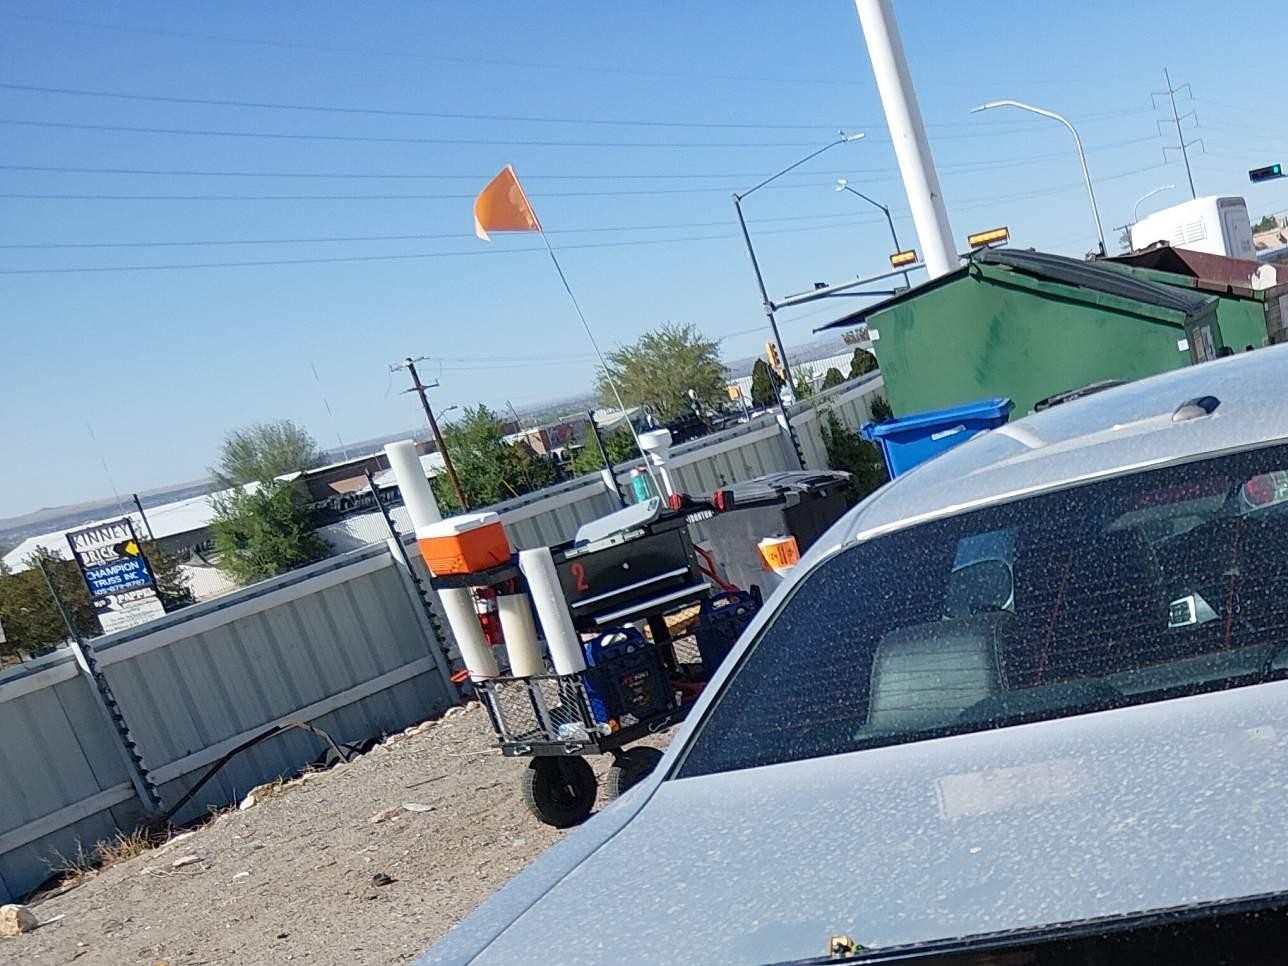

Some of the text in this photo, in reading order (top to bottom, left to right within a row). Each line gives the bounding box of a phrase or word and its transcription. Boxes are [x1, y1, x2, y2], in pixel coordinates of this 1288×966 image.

[73, 523, 130, 548] KINNEY
[82, 545, 119, 564] BRICK
[86, 561, 139, 581] CHAMPION
[570, 562, 589, 591] 2
[93, 575, 122, 588] TRUSS
